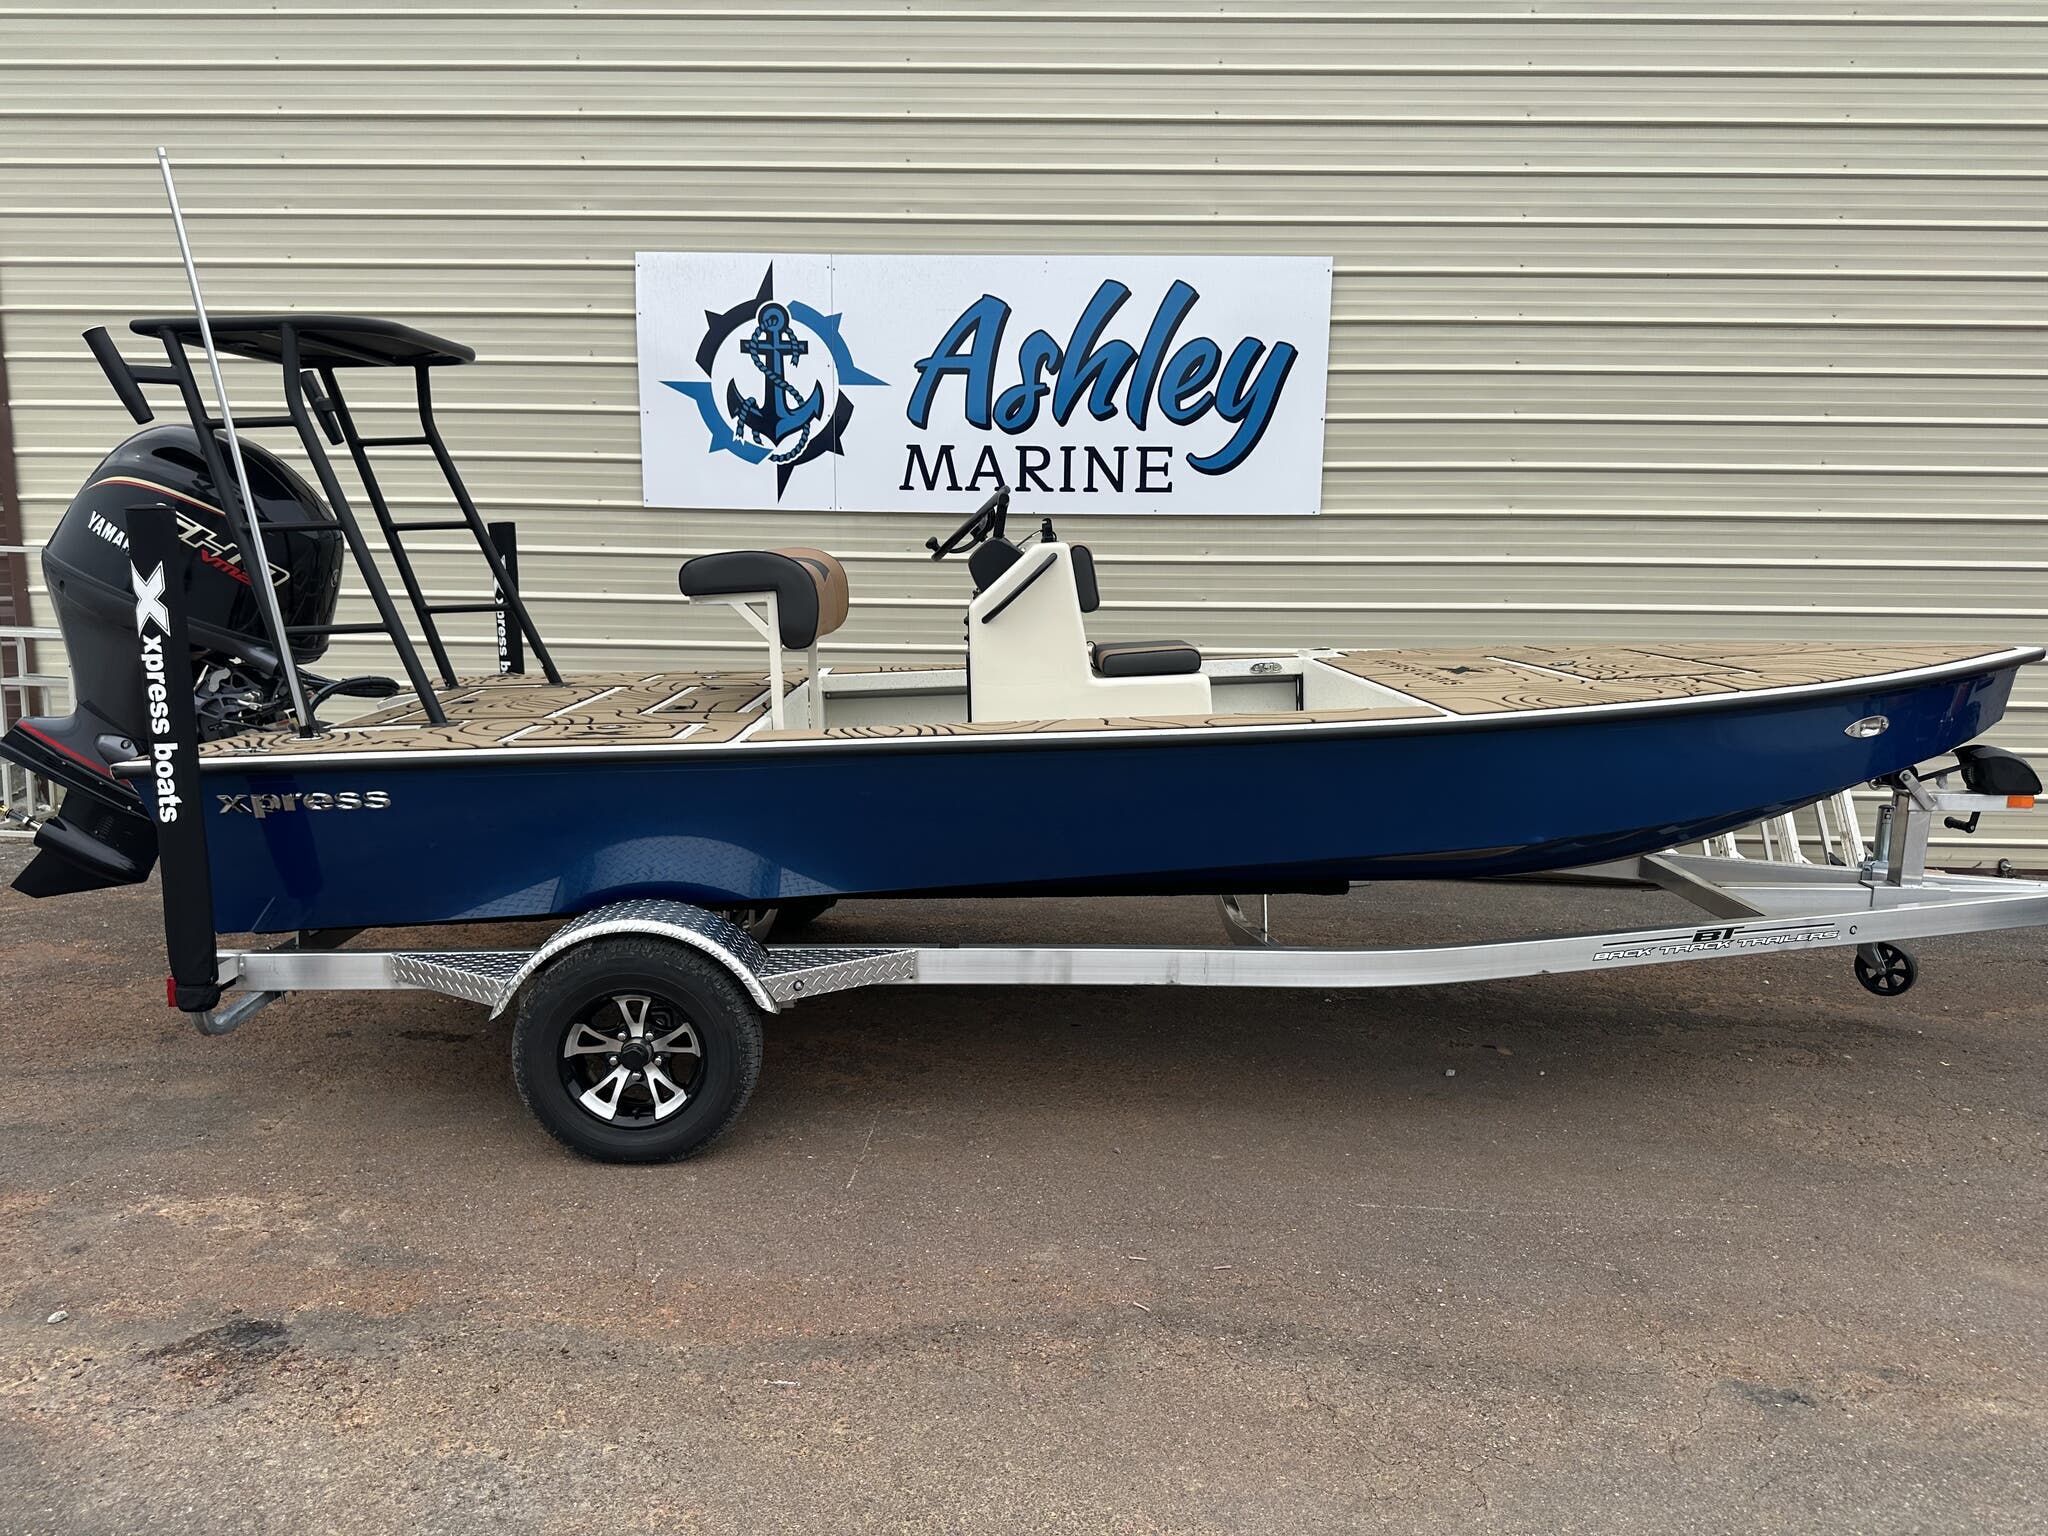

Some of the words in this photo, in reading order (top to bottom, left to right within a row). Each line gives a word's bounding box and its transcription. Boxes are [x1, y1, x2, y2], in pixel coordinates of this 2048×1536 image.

[906, 279, 1299, 476] Ashley
[899, 444, 1174, 493] MARINE
[88, 510, 130, 551] YAMA
[141, 634, 171, 735] xpress
[154, 742, 182, 823] boats
[216, 791, 392, 819] xpress
[1592, 947, 1657, 961] BACK
[1659, 940, 1734, 955] TRACK
[1737, 931, 1839, 948] TRAILERS
